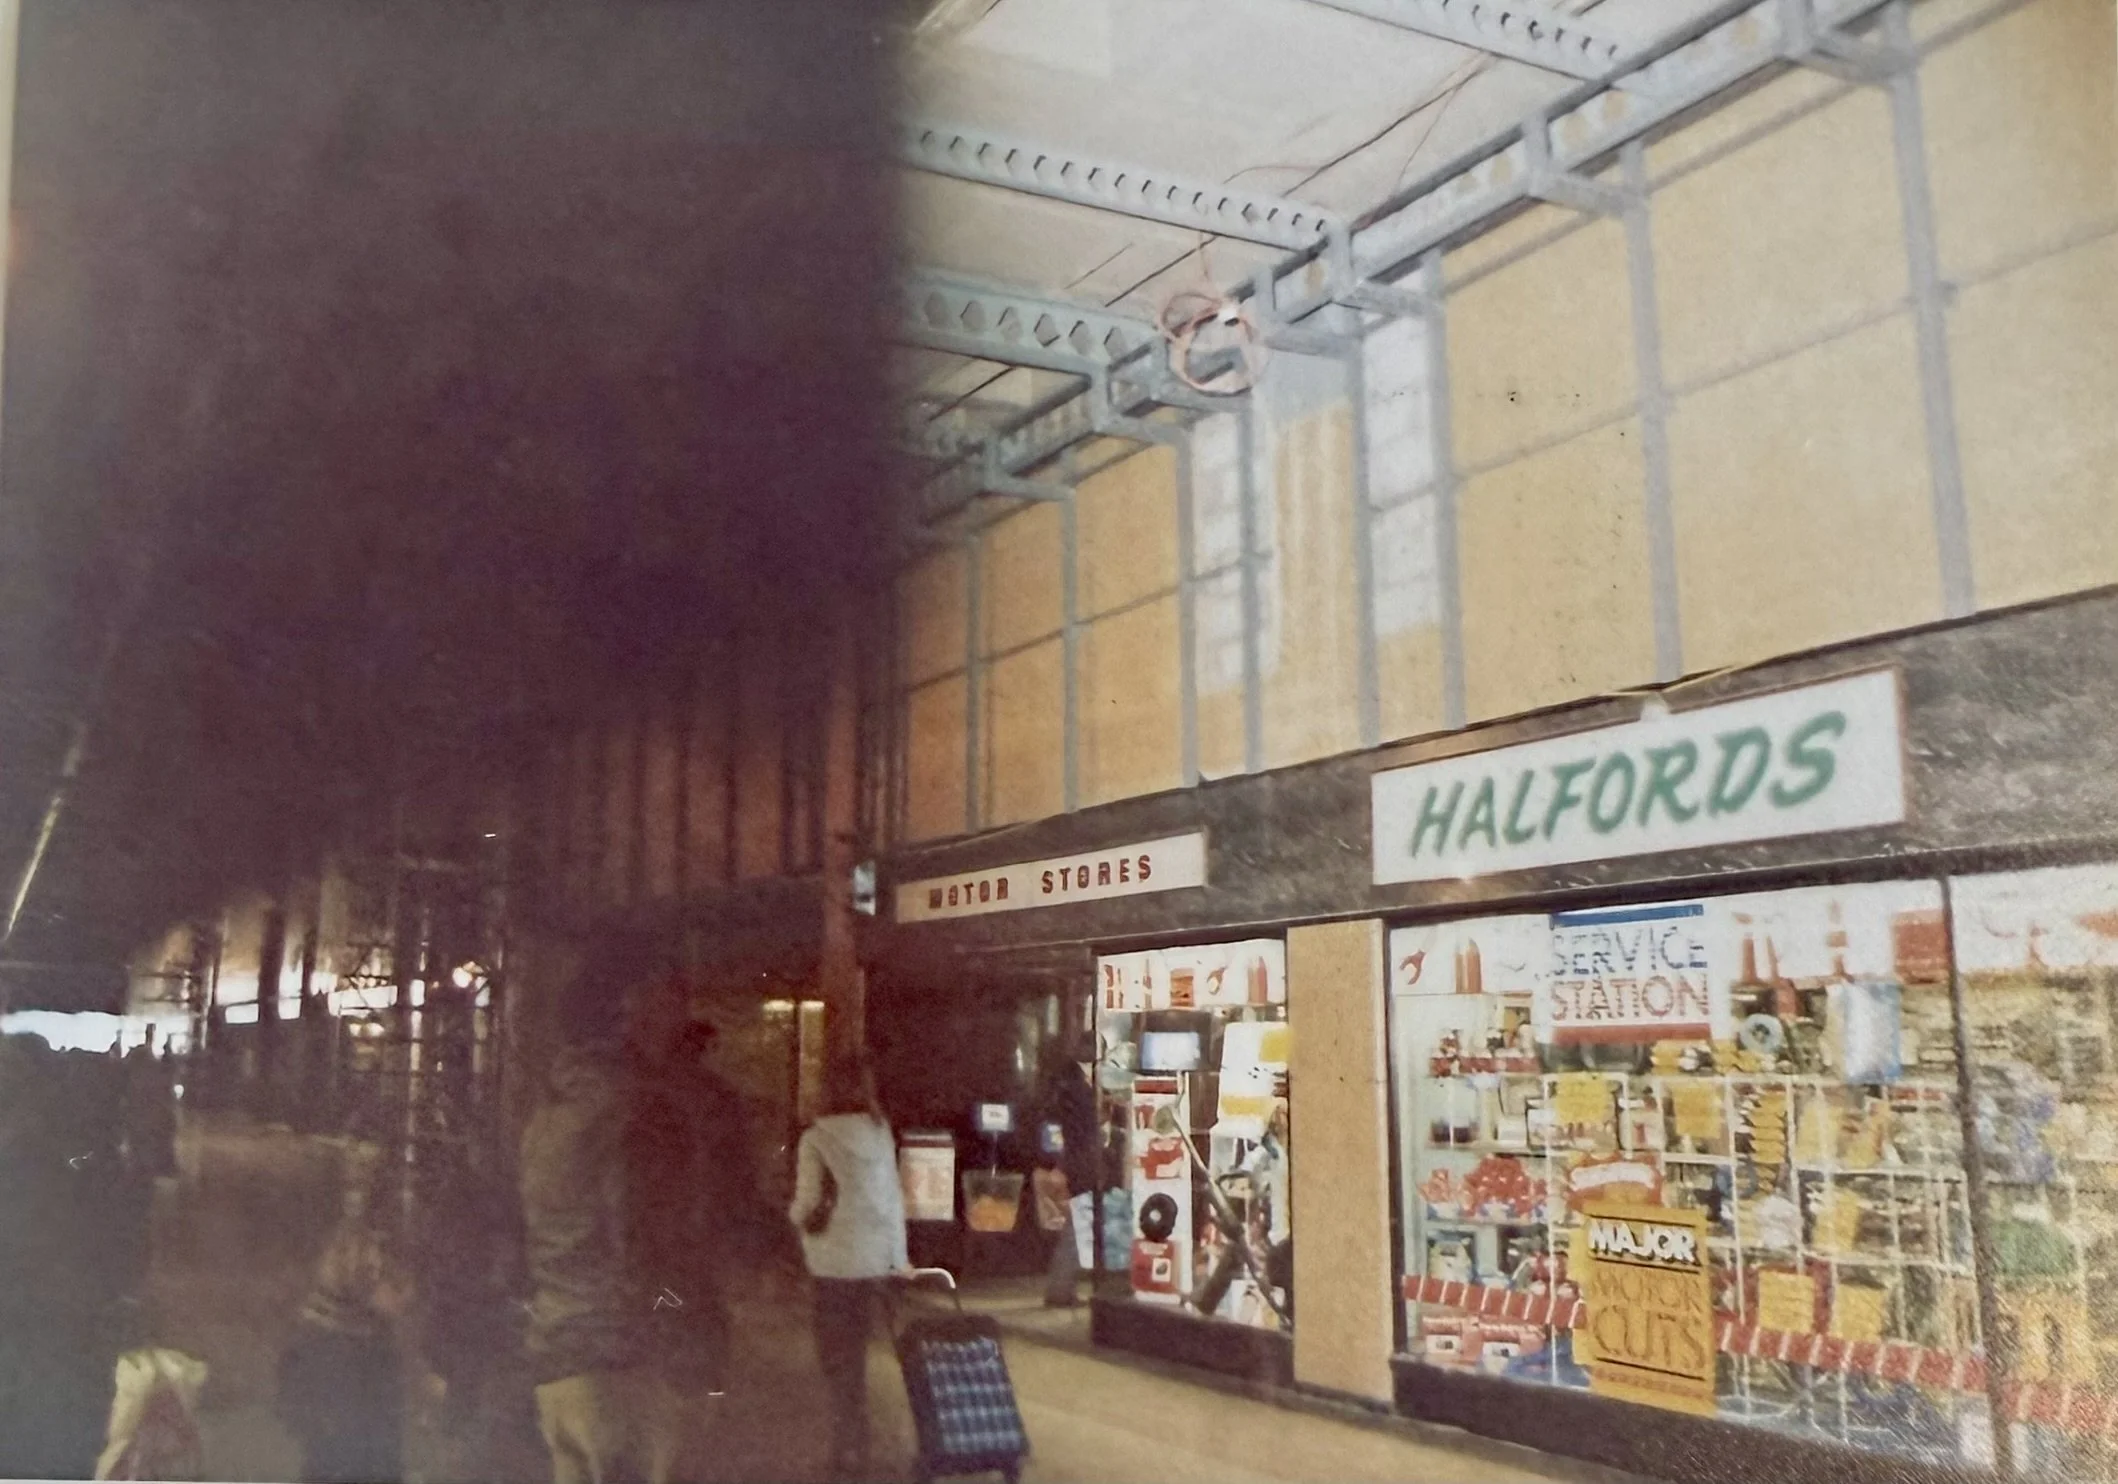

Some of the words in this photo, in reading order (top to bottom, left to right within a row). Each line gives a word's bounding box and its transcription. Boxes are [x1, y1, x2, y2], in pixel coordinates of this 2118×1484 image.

[1410, 709, 1846, 858] HALFORDS
[928, 877, 1009, 909] MOTOR
[1041, 854, 1152, 894] STORES
[1552, 926, 1708, 976] SERVICE
[1551, 973, 1709, 1021] STATION
[1588, 1221, 1701, 1267] MAJOR
